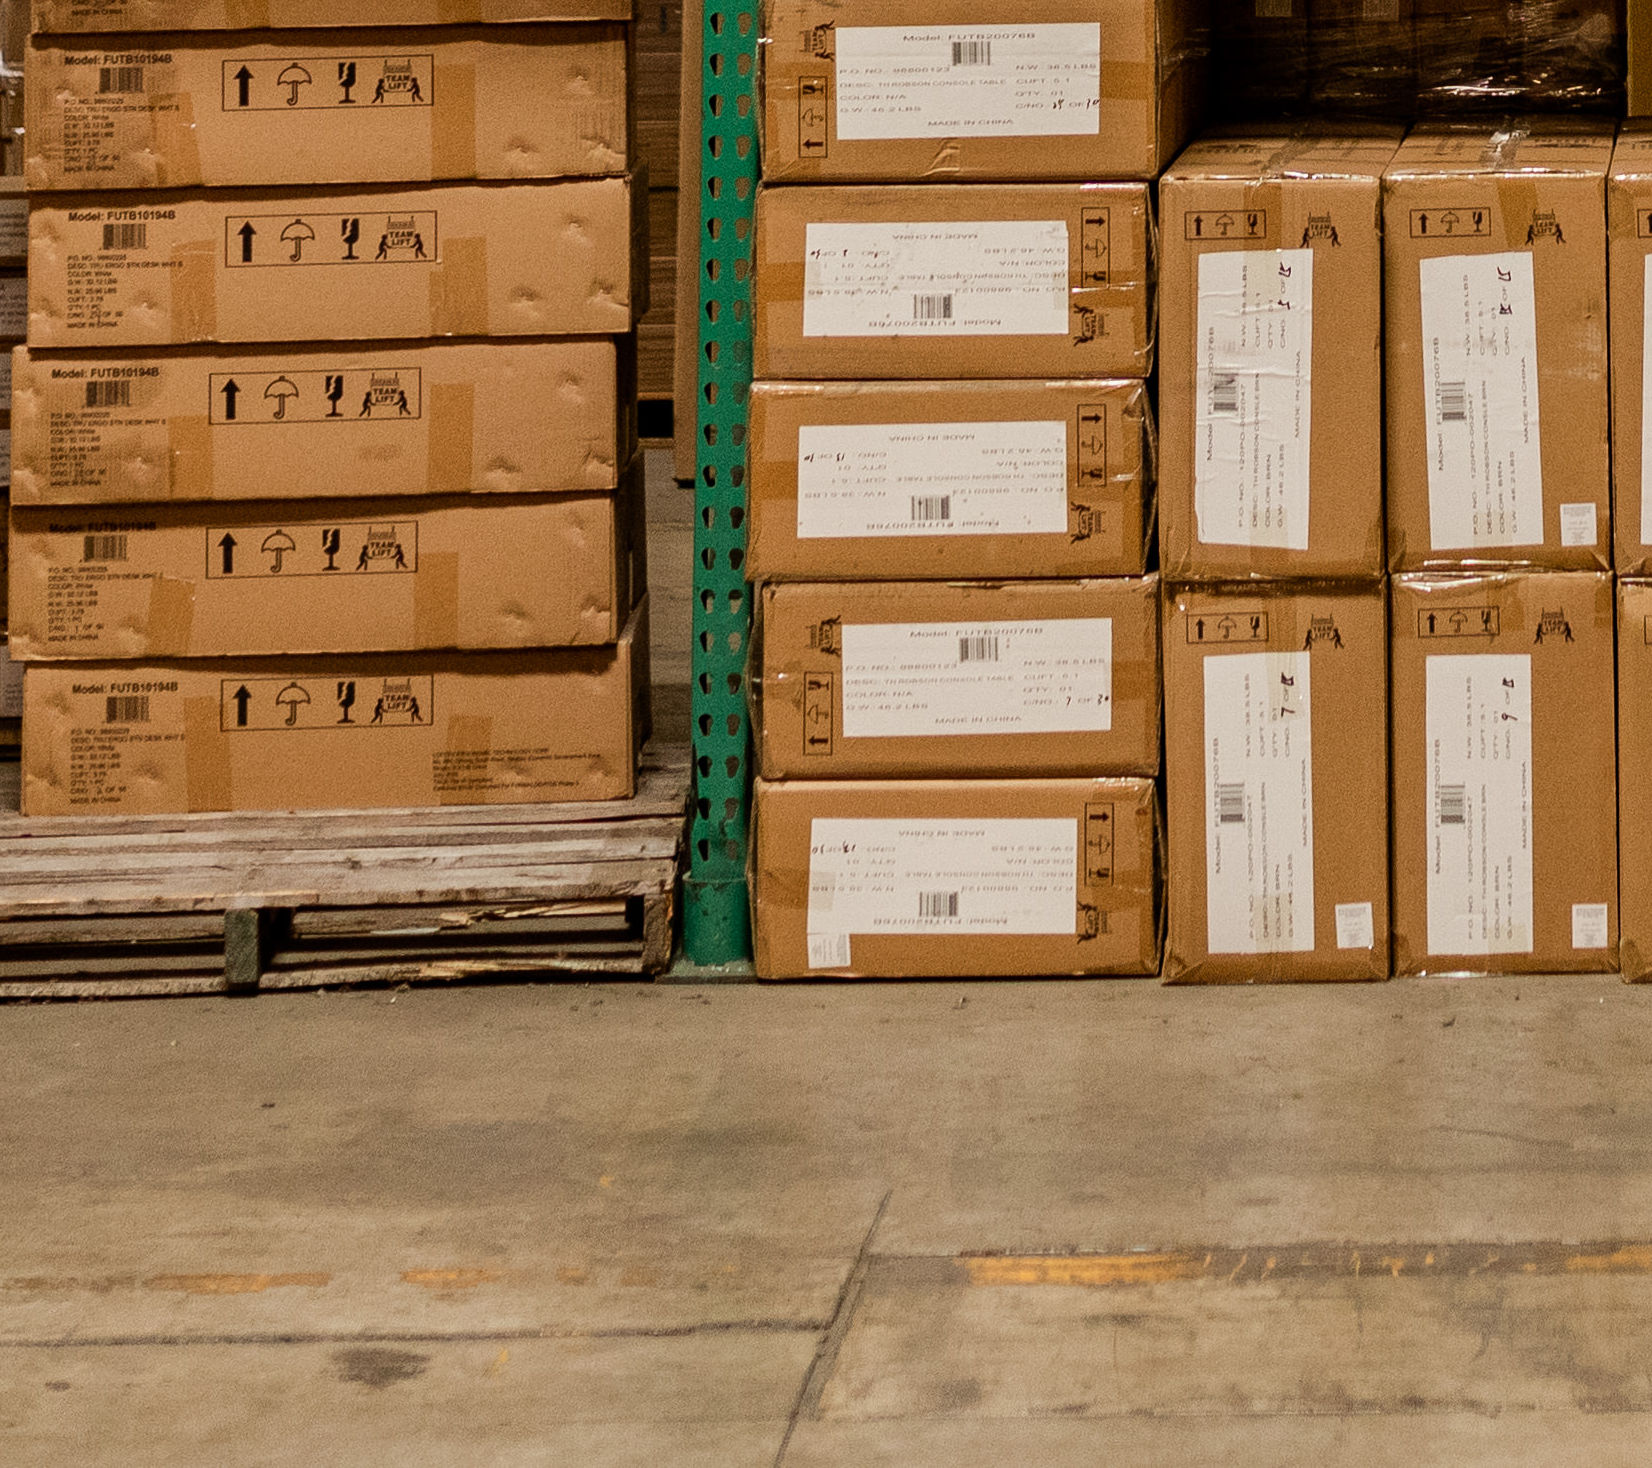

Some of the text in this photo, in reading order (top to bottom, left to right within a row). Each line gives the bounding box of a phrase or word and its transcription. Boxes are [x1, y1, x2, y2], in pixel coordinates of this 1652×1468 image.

[64, 50, 173, 64] Model: FUTB10194B
[52, 367, 161, 380] Model: FUTB10194B
[72, 682, 179, 695] Model: FUTB10194B
